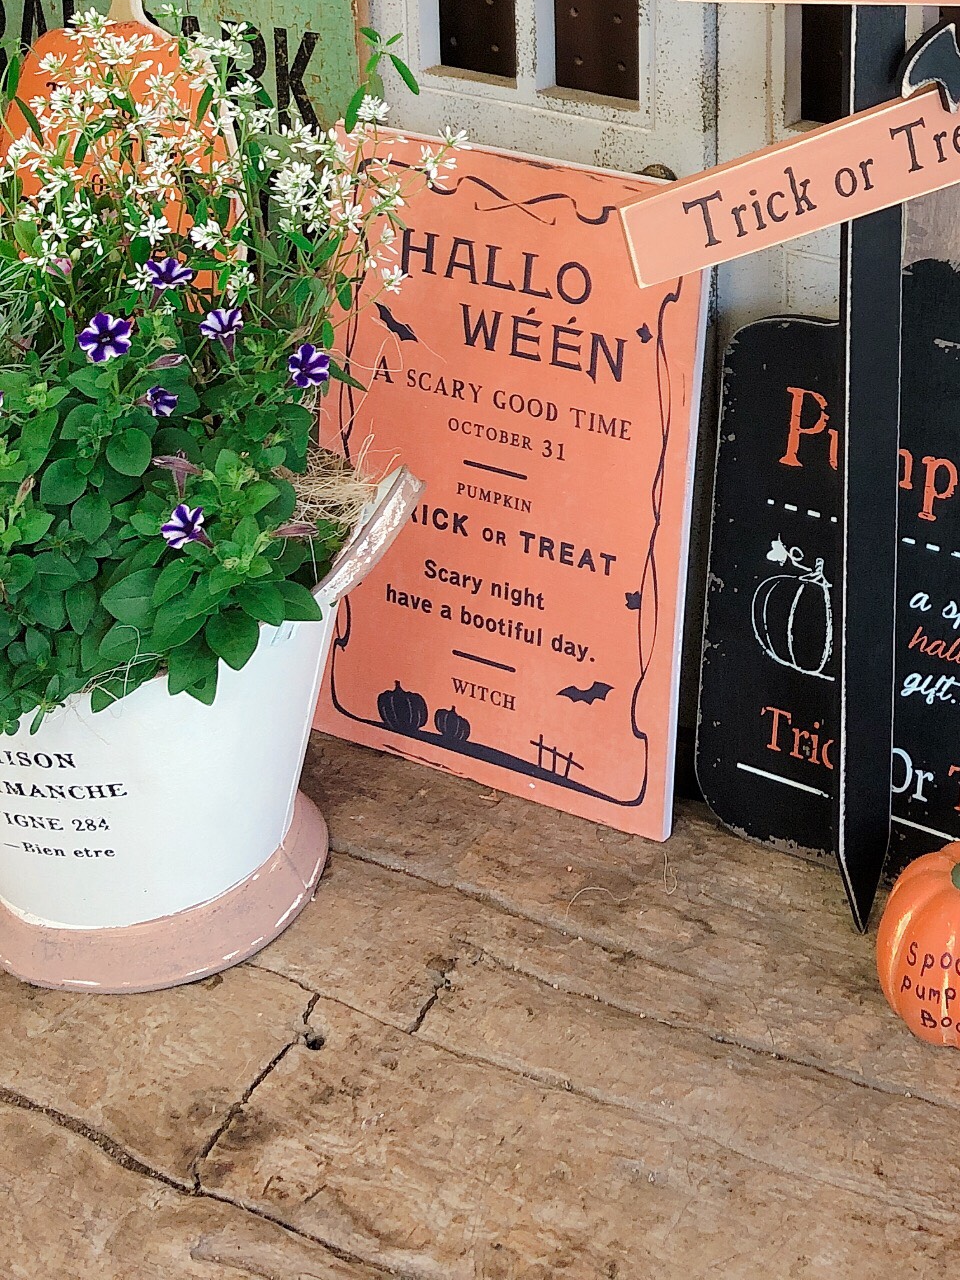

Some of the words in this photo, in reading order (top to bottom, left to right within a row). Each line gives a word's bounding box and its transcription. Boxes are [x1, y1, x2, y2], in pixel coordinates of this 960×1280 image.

[681, 166, 818, 249] Trick
[834, 158, 875, 198] or
[400, 226, 592, 305] HALLO
[373, 355, 395, 384] A
[406, 368, 483, 404] SCARY
[492, 389, 559, 422] GOOD
[569, 406, 633, 441] TIME
[447, 417, 533, 451] OCTOBER
[541, 439, 566, 462] 31
[456, 481, 533, 514] PUMPKIN
[410, 504, 469, 538] ICK
[519, 530, 617, 577] TREAT
[423, 558, 483, 595] Scary
[490, 580, 545, 611] night
[909, 591, 932, 612] a
[385, 583, 433, 614] have
[440, 603, 453, 621] a
[460, 605, 543, 647] bootiful
[551, 633, 596, 663] day.
[450, 676, 517, 712] WITCH
[0, 750, 77, 769] ISON
[0, 780, 129, 800] MANCHE
[0, 810, 64, 831] IGNE
[71, 818, 111, 832] 284
[73, 847, 117, 858] etre
